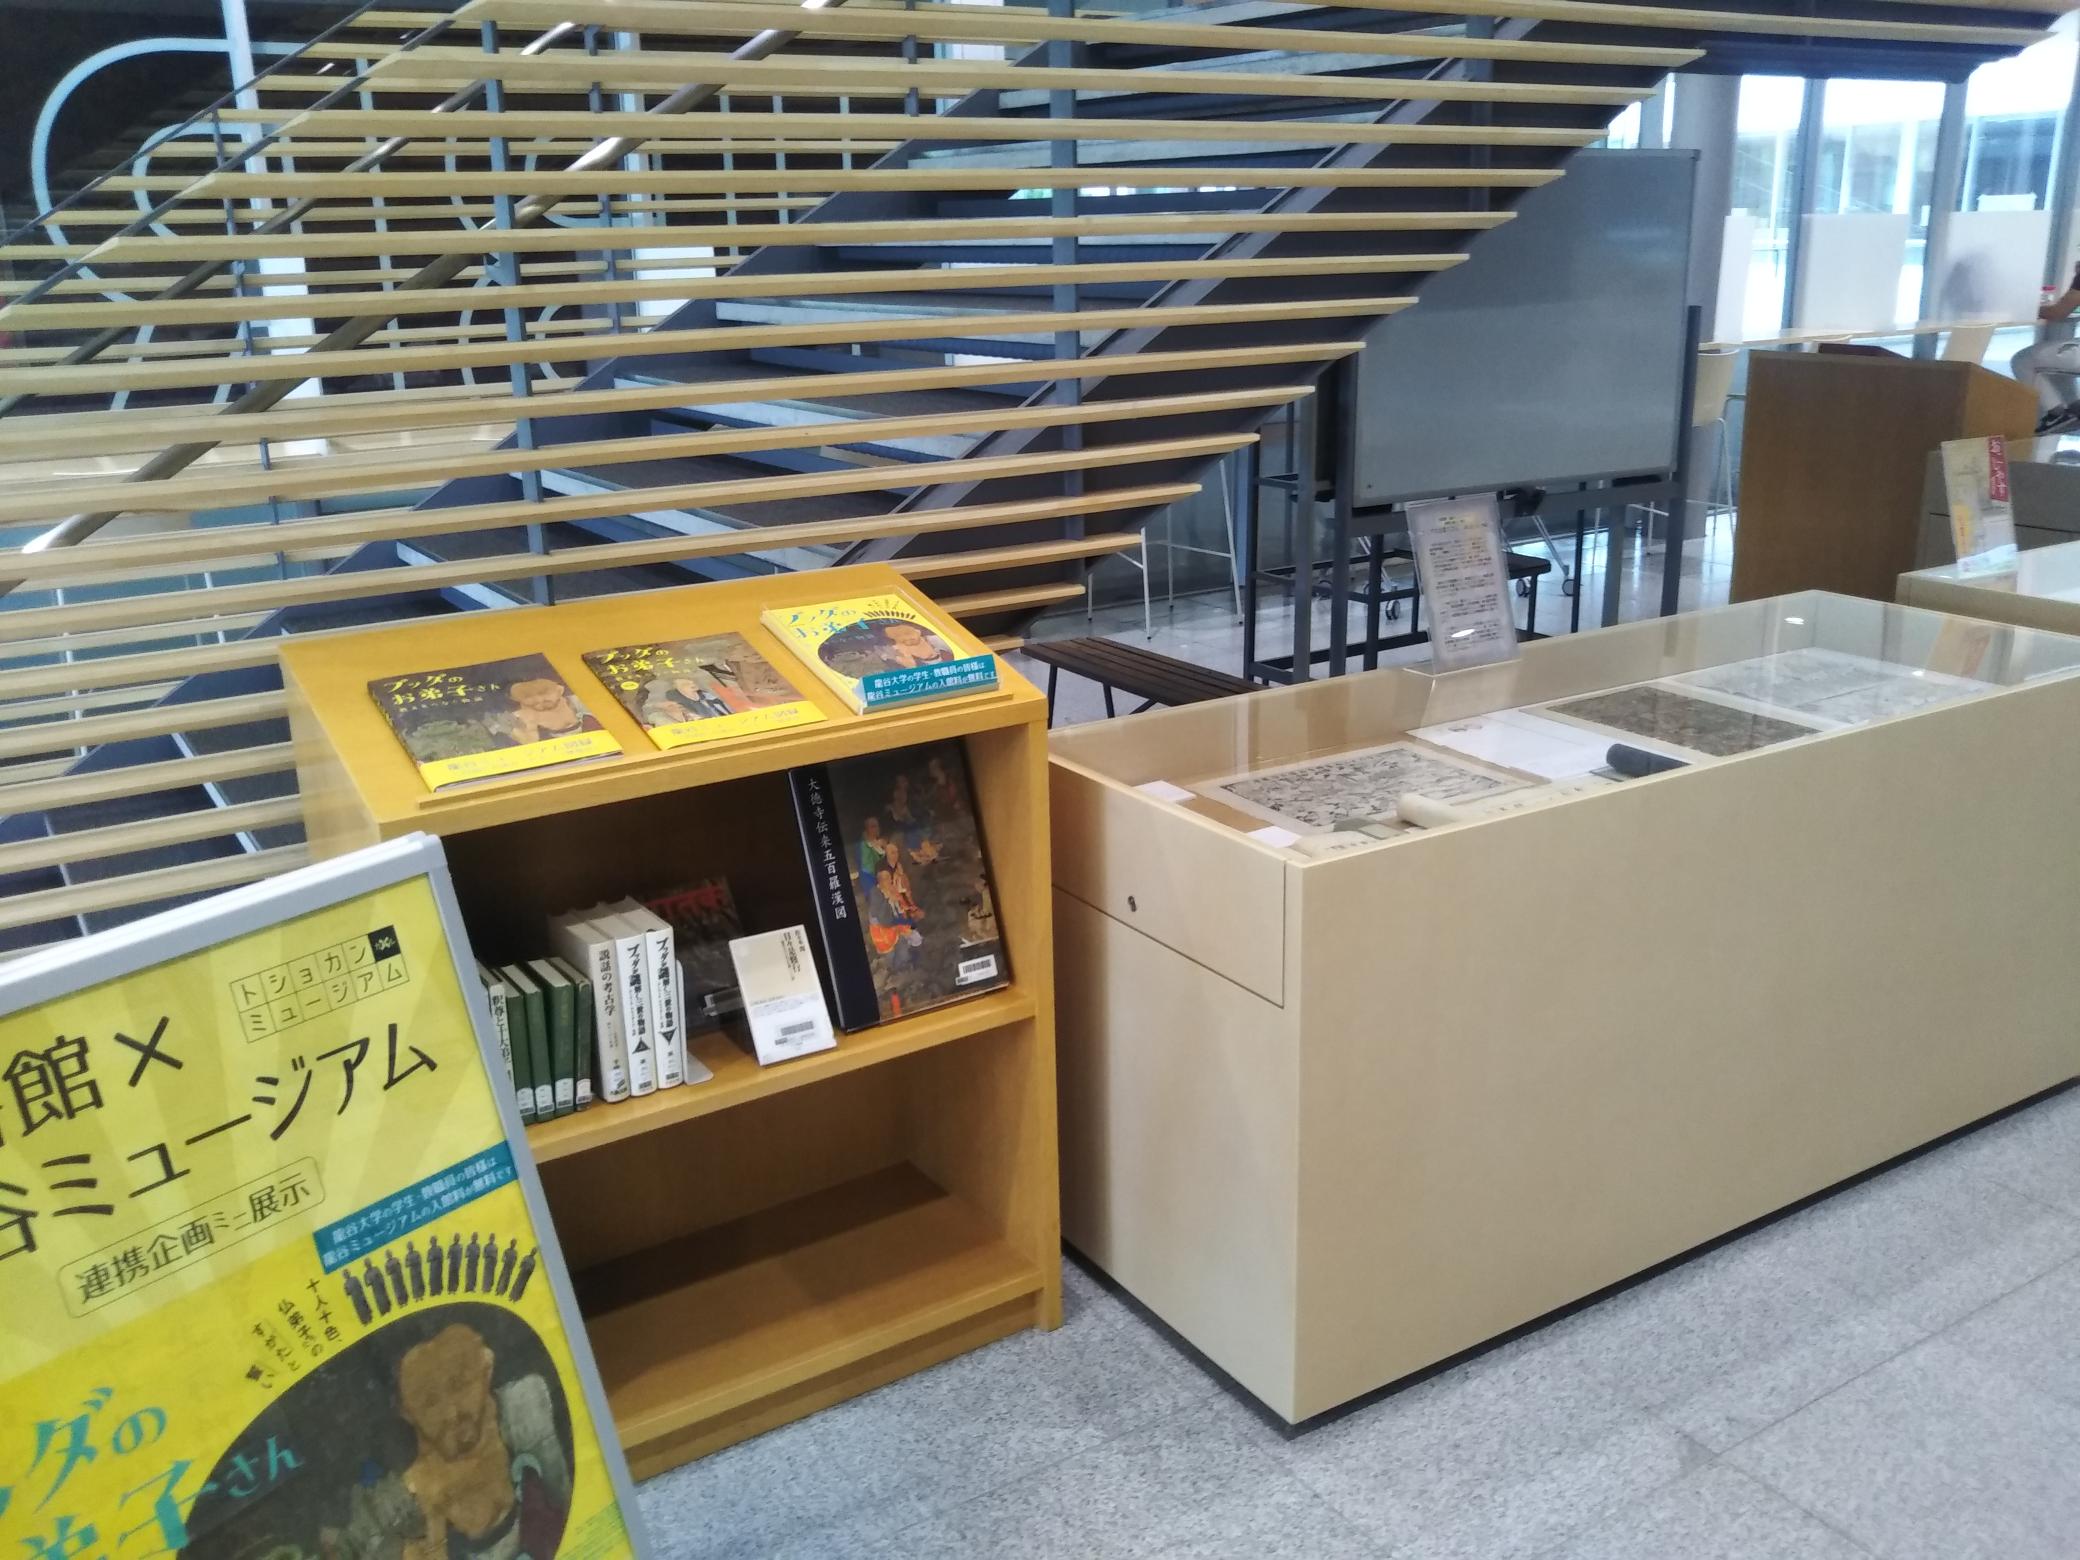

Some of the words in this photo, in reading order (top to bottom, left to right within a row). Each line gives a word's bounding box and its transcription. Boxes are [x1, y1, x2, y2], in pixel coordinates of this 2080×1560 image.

[250, 962, 403, 1032] ミュージアム
[0, 1015, 184, 1148] 館×
[76, 1171, 312, 1305] 連携企画ミニ展示
[0, 1387, 167, 1518] ダの
